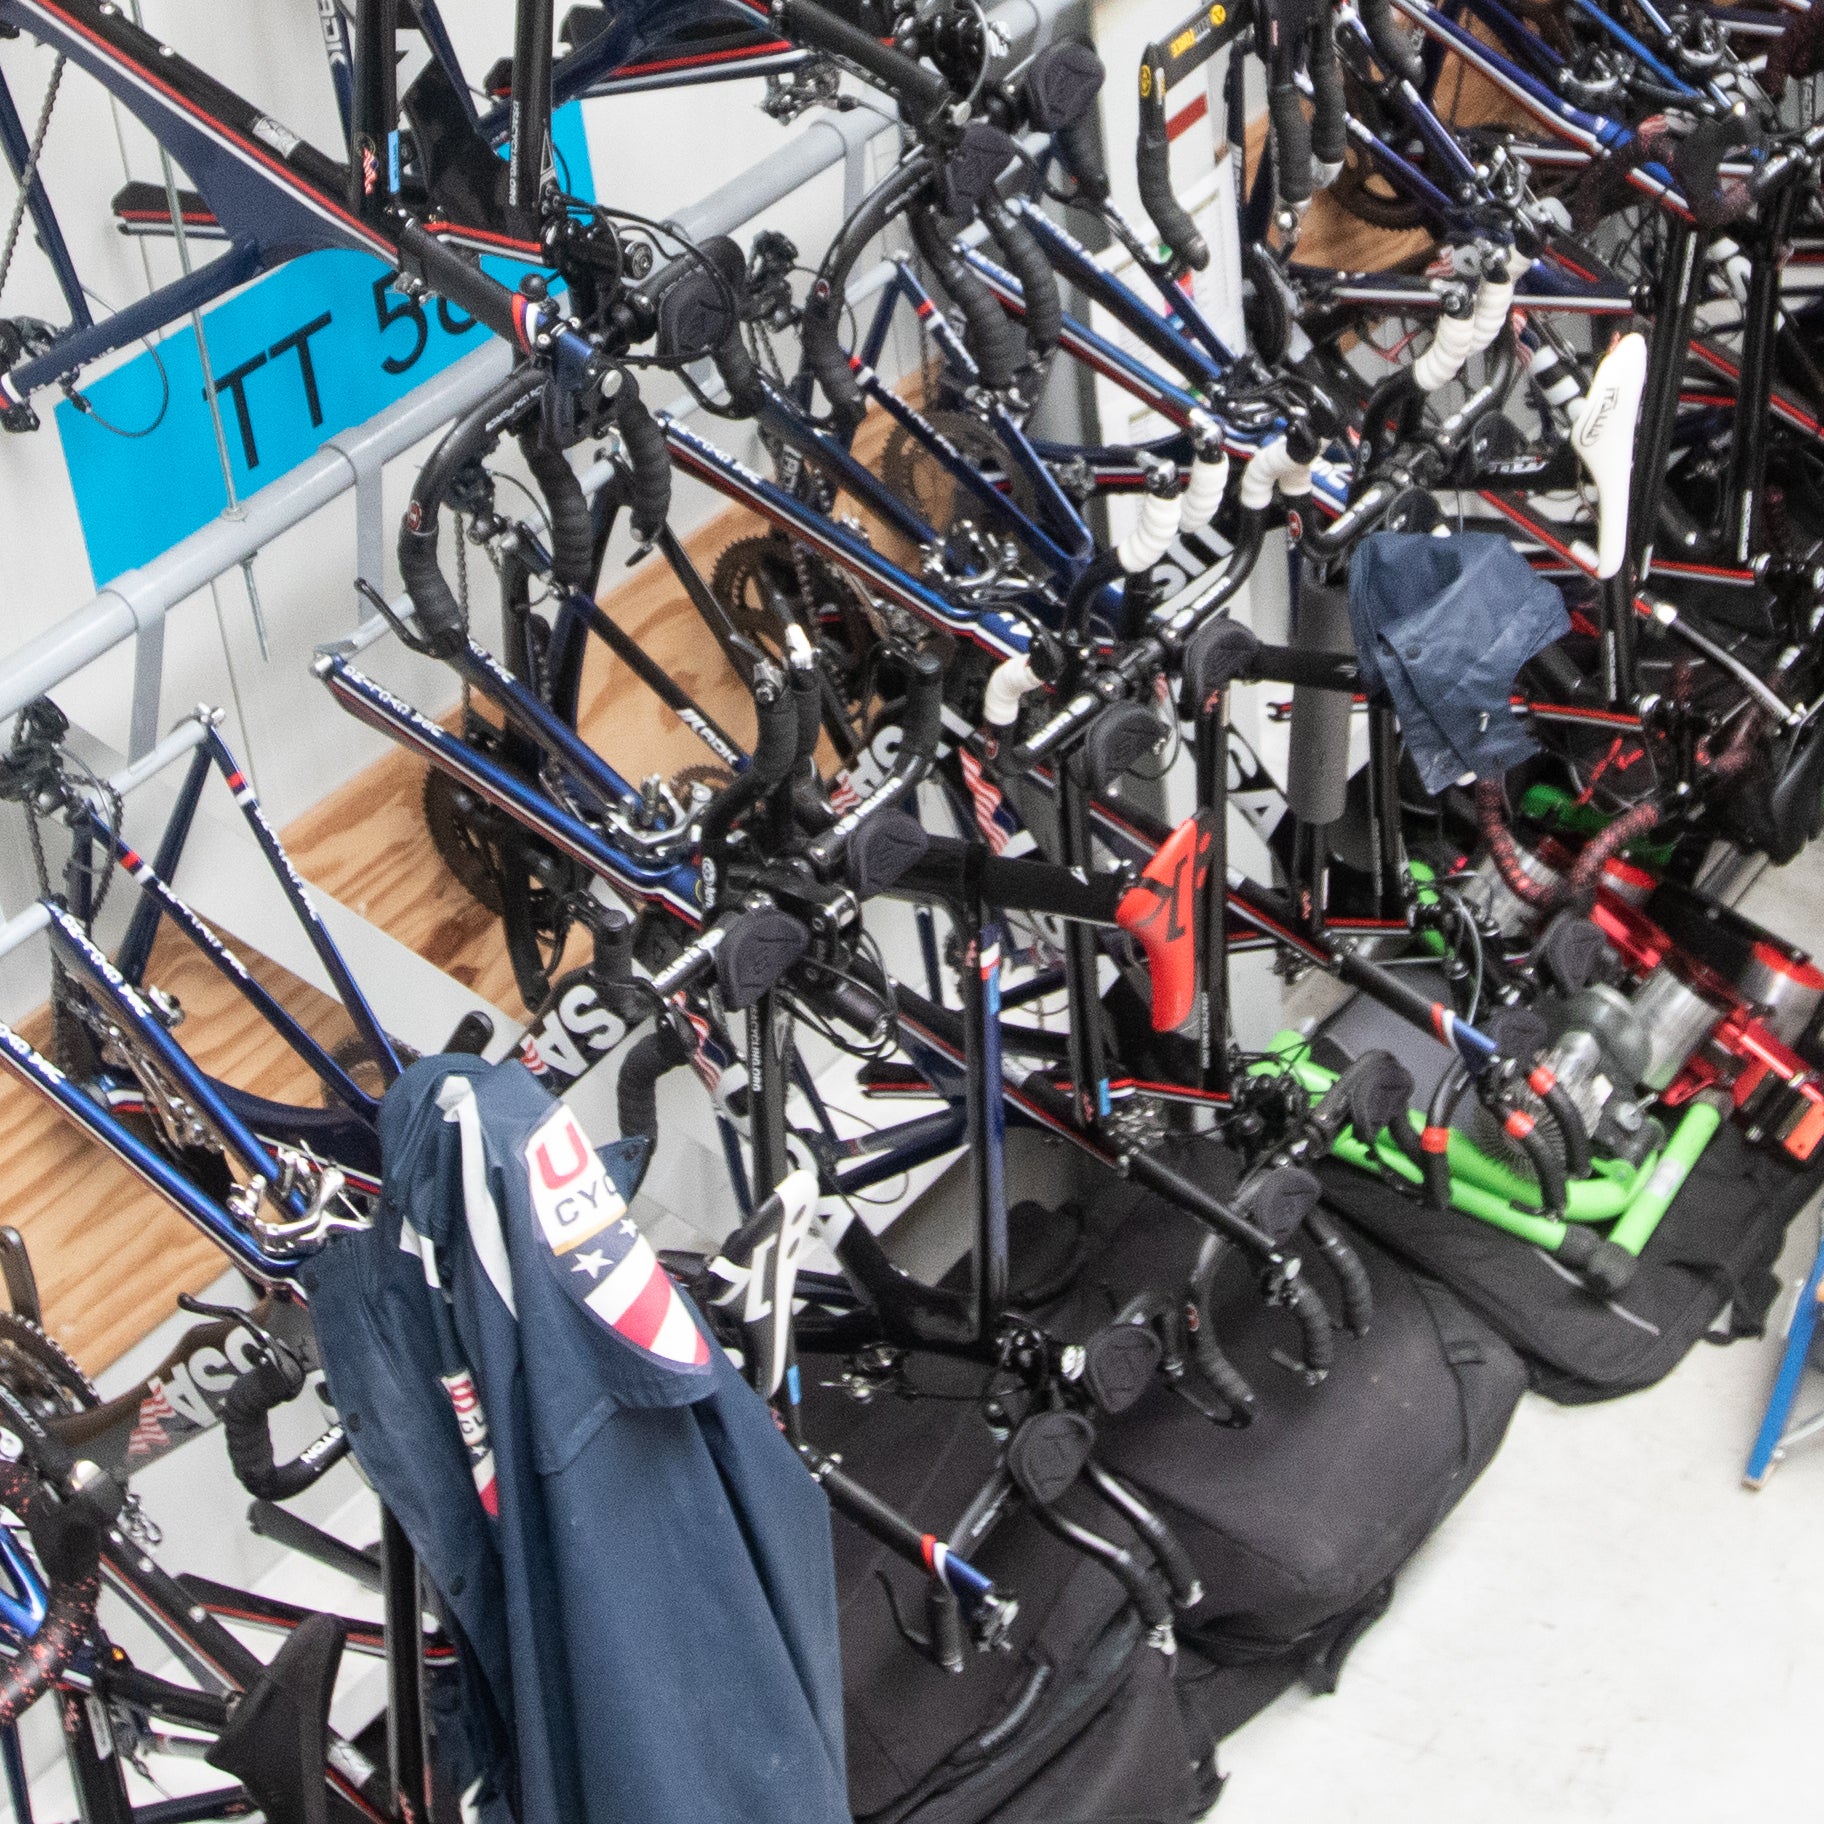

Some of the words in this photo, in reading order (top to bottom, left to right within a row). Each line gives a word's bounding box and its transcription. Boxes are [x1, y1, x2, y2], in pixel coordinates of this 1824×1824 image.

[508, 100, 520, 208] USACYCLING.ORG
[201, 309, 332, 472] TT
[341, 664, 414, 718] CYCLING
[62, 914, 126, 989] CYCLING
[25, 1053, 66, 1087] USA
